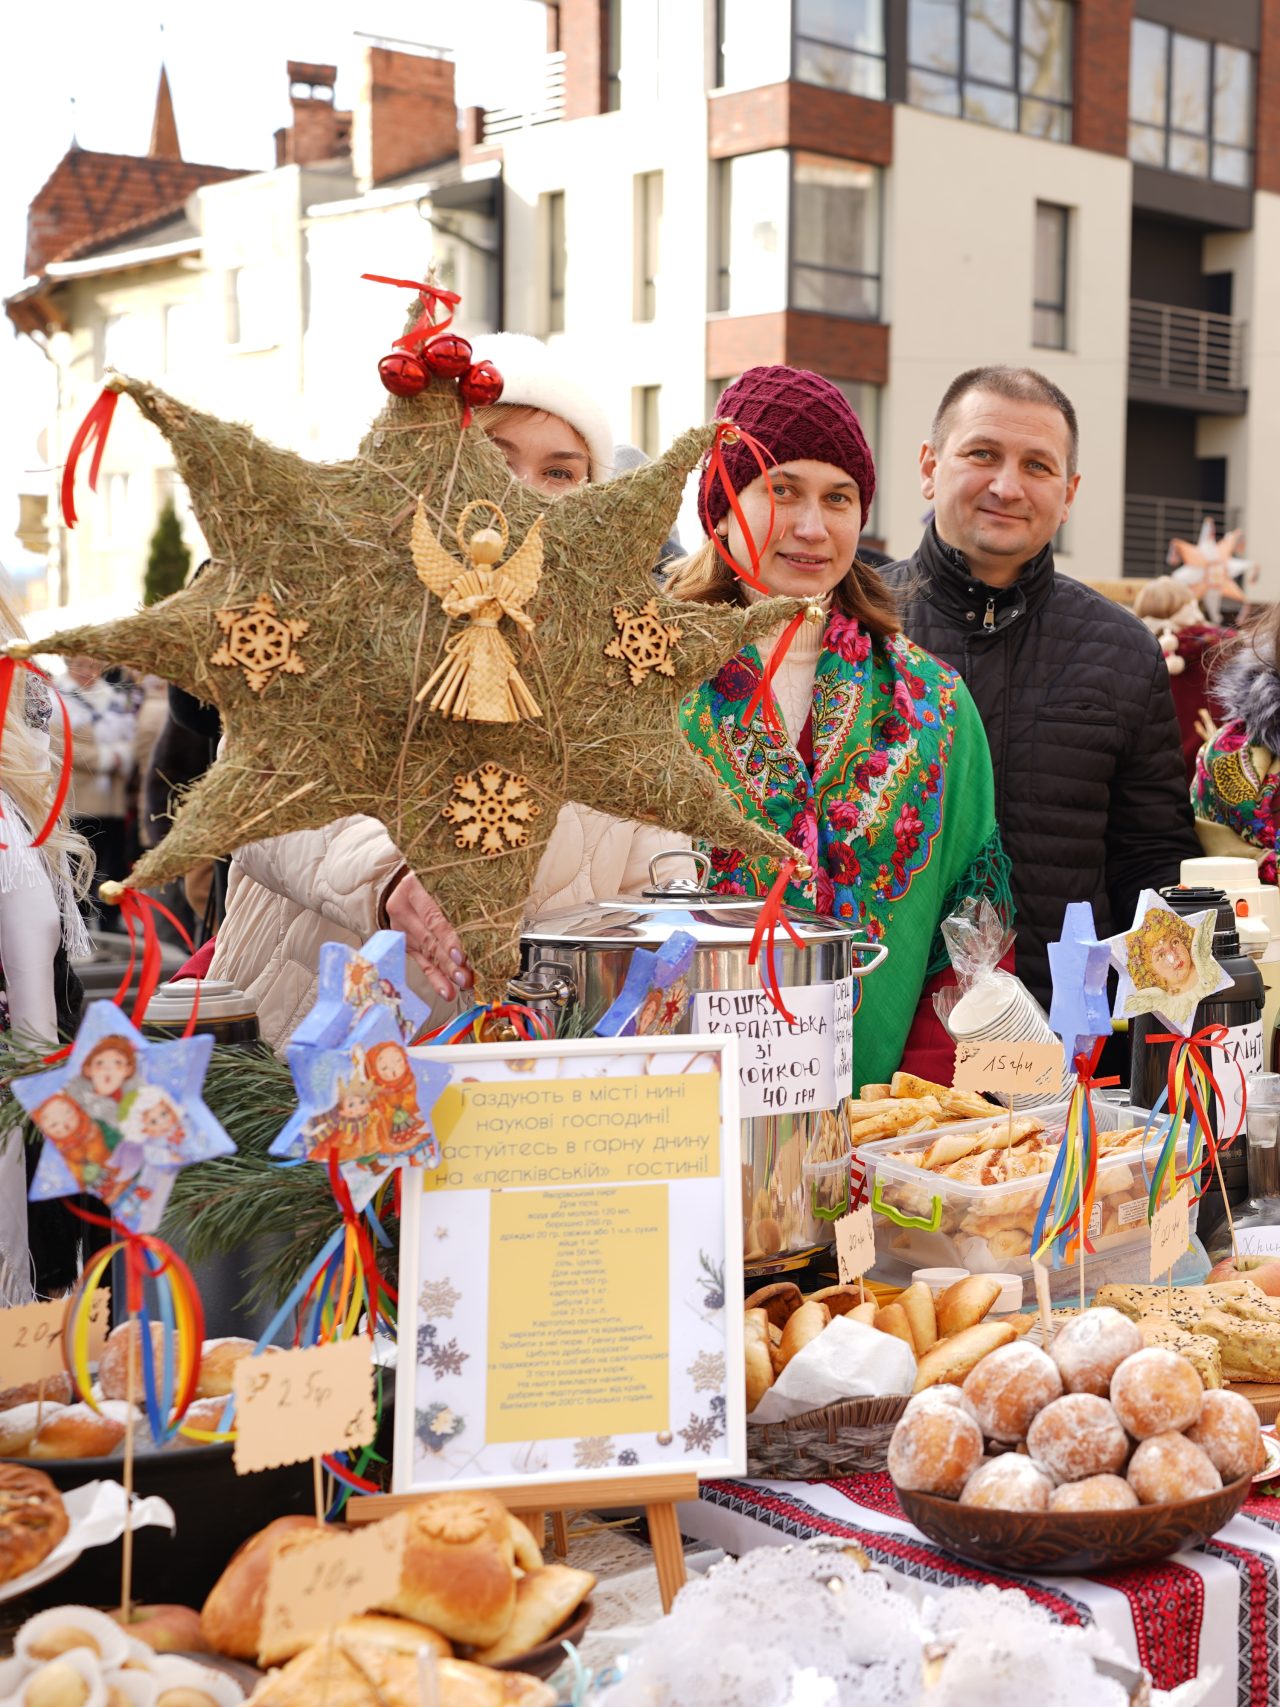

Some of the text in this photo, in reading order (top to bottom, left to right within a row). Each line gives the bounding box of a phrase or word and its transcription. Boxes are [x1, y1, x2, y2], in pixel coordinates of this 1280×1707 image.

[461, 1082, 685, 1109] Газдують в місті нині
[763, 1086, 788, 1109] 40
[476, 1105, 670, 1134] наукові господині!
[566, 1141, 576, 1153] в
[584, 1138, 646, 1155] гарну
[653, 1135, 710, 1153] днину
[435, 1171, 463, 1185] на
[627, 1153, 708, 1176] гостині!
